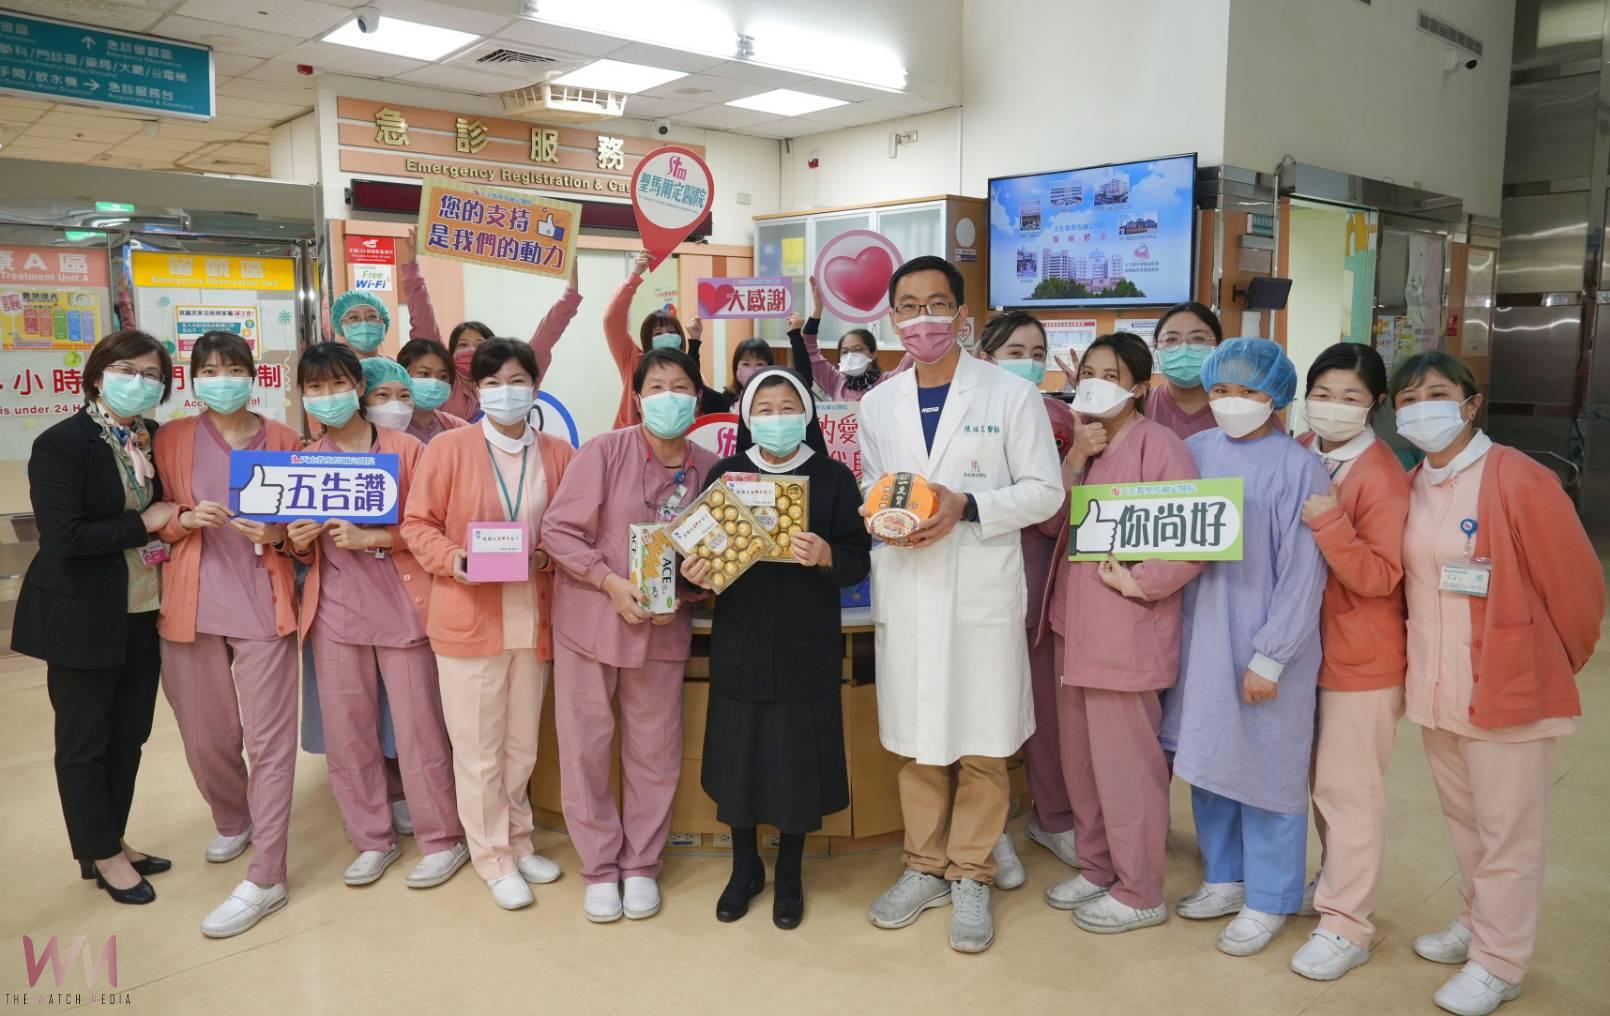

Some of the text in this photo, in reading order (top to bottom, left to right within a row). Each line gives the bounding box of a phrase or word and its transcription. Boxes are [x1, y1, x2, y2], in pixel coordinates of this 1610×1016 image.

[405, 158, 497, 182] Emergency
[501, 168, 591, 190] Registration
[593, 179, 604, 190] &
[637, 172, 707, 209] 聖馬爾定醫院
[439, 194, 531, 233] 您的支持
[428, 223, 565, 269] 是我們的動力
[1, 271, 89, 282] Treatment Unit A
[151, 275, 203, 285] Emergency
[206, 278, 258, 287] Observation
[356, 279, 386, 289] Wi-Fi
[362, 270, 383, 279] Free
[727, 287, 786, 313] 大感謝
[15, 405, 50, 415] under
[54, 404, 69, 413] 24
[285, 472, 385, 512] 五告讚
[1118, 501, 1226, 548] 你尚好
[661, 557, 673, 584] ACE
